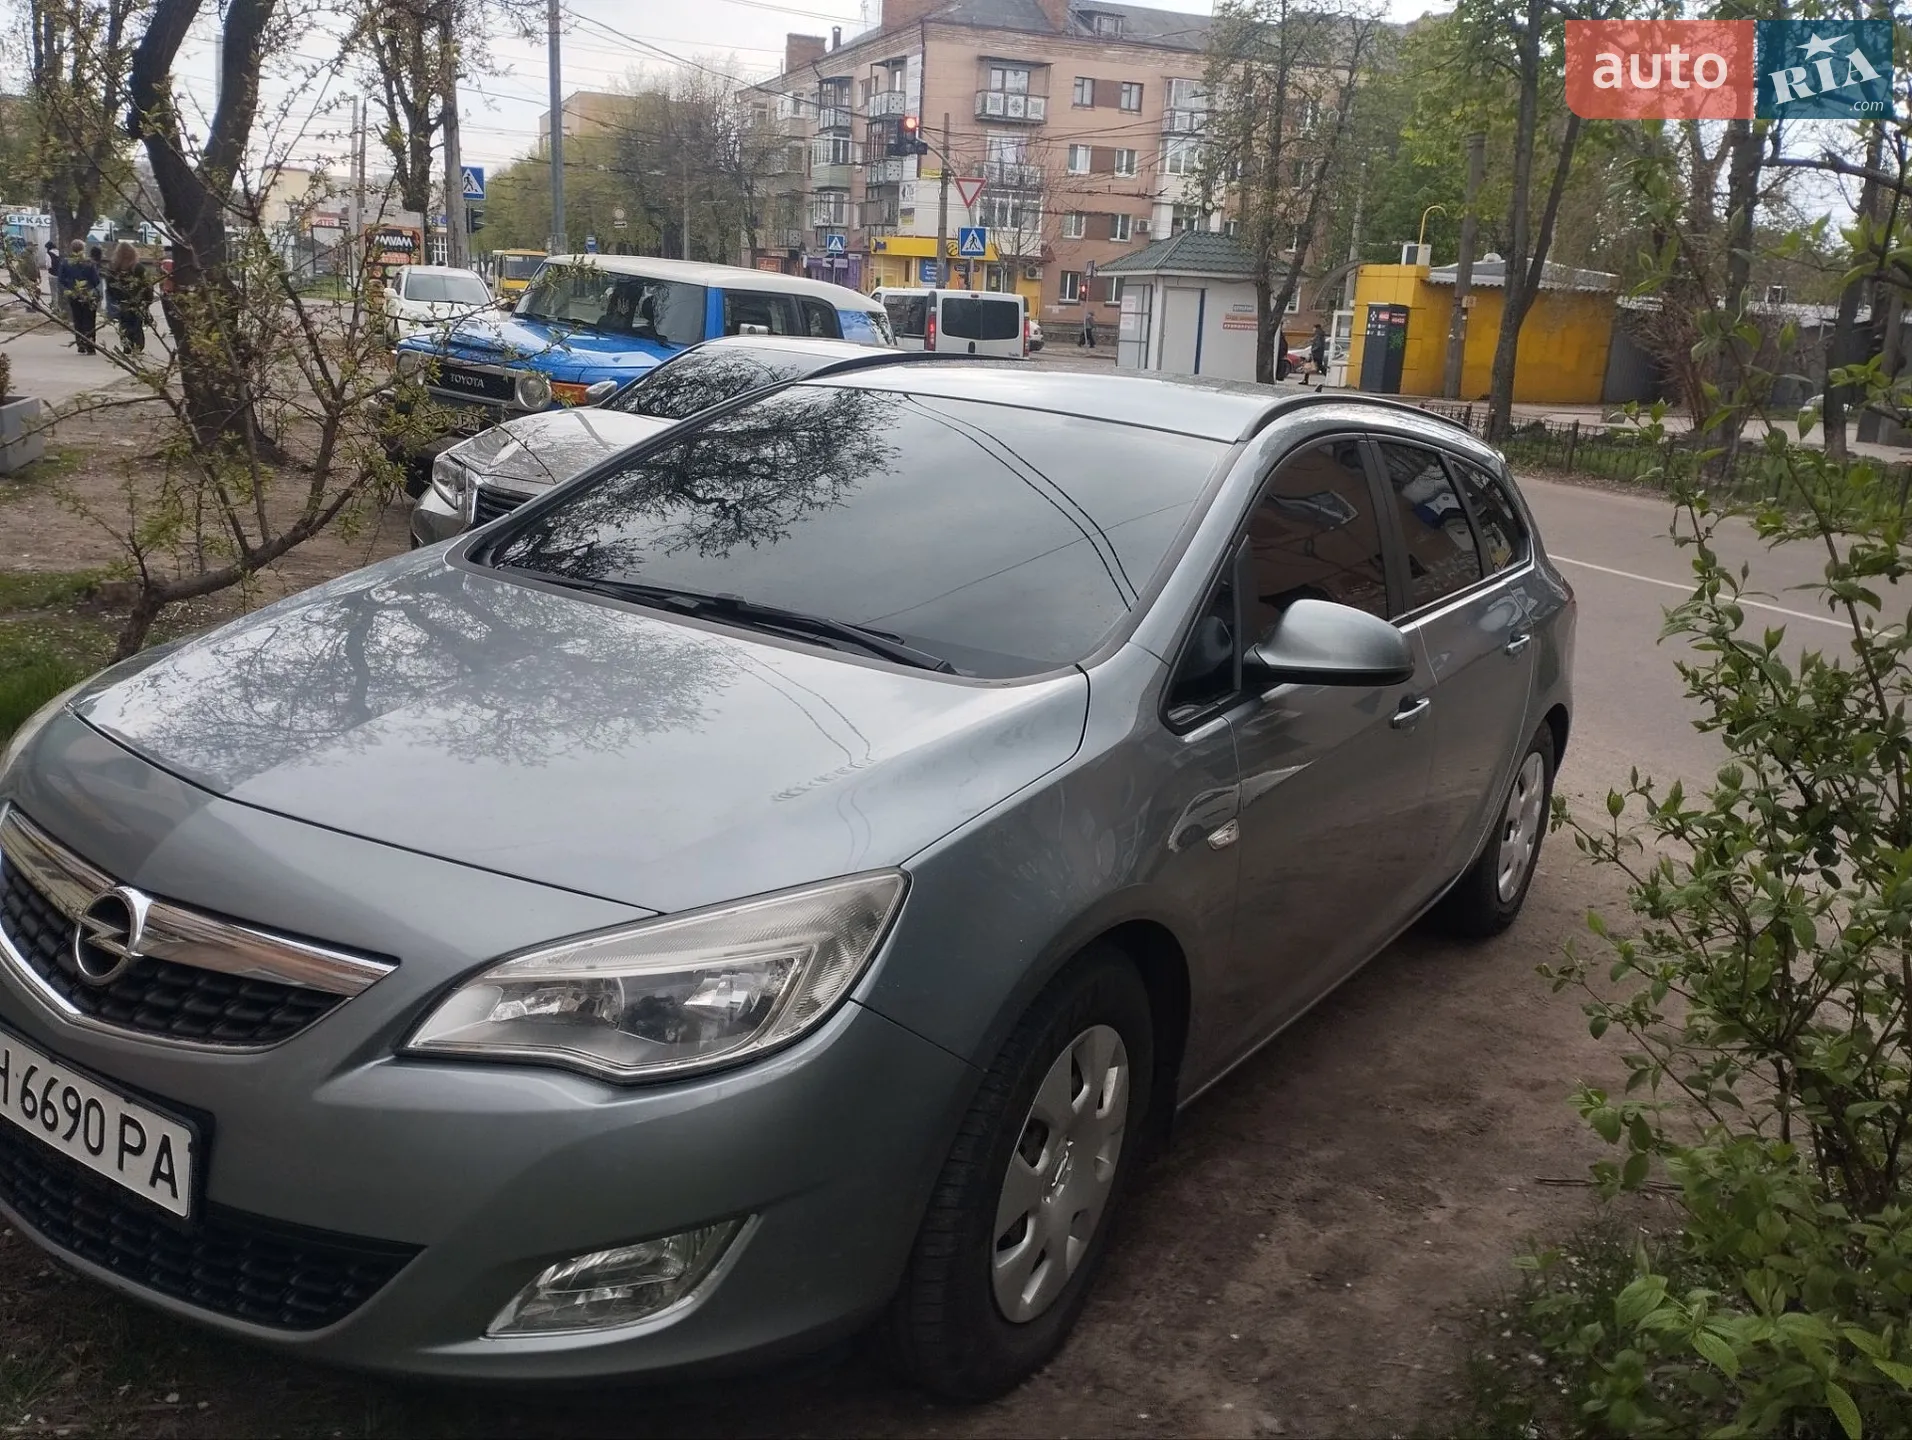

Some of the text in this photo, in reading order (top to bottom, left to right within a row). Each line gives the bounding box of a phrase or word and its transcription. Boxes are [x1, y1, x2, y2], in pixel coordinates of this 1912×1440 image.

[450, 374, 485, 388] TOYOTA
[20, 1064, 105, 1157] 6690
[117, 1112, 179, 1200] PA
